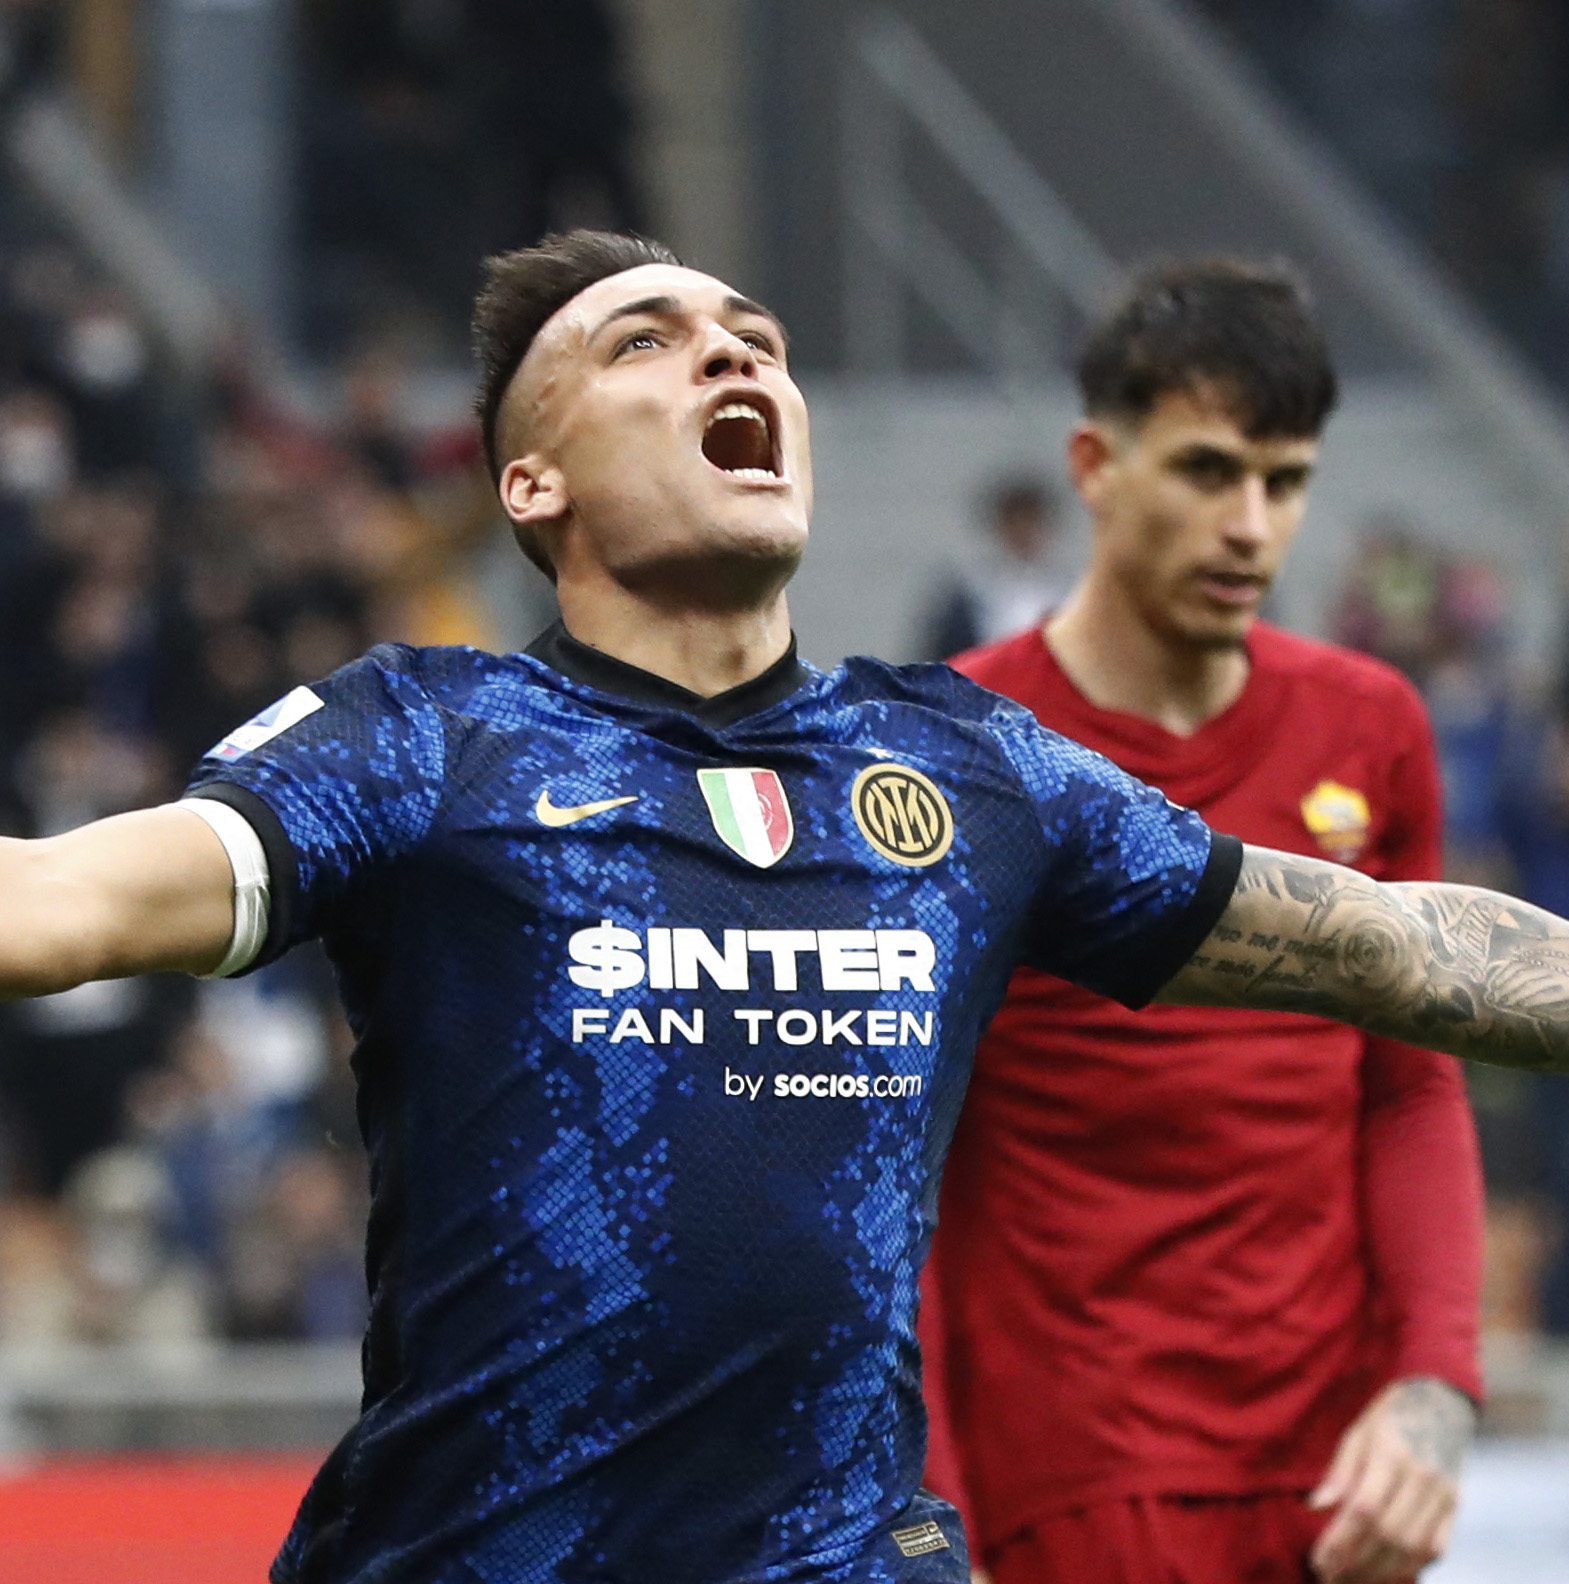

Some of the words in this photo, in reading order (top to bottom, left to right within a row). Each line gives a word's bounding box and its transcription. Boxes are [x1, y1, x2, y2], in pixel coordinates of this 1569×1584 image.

[567, 918, 937, 998] $INTER
[572, 1007, 704, 1044] FAN
[734, 1008, 934, 1046] TOKEN
[724, 1065, 765, 1101] by
[773, 1073, 922, 1098] socios.com
